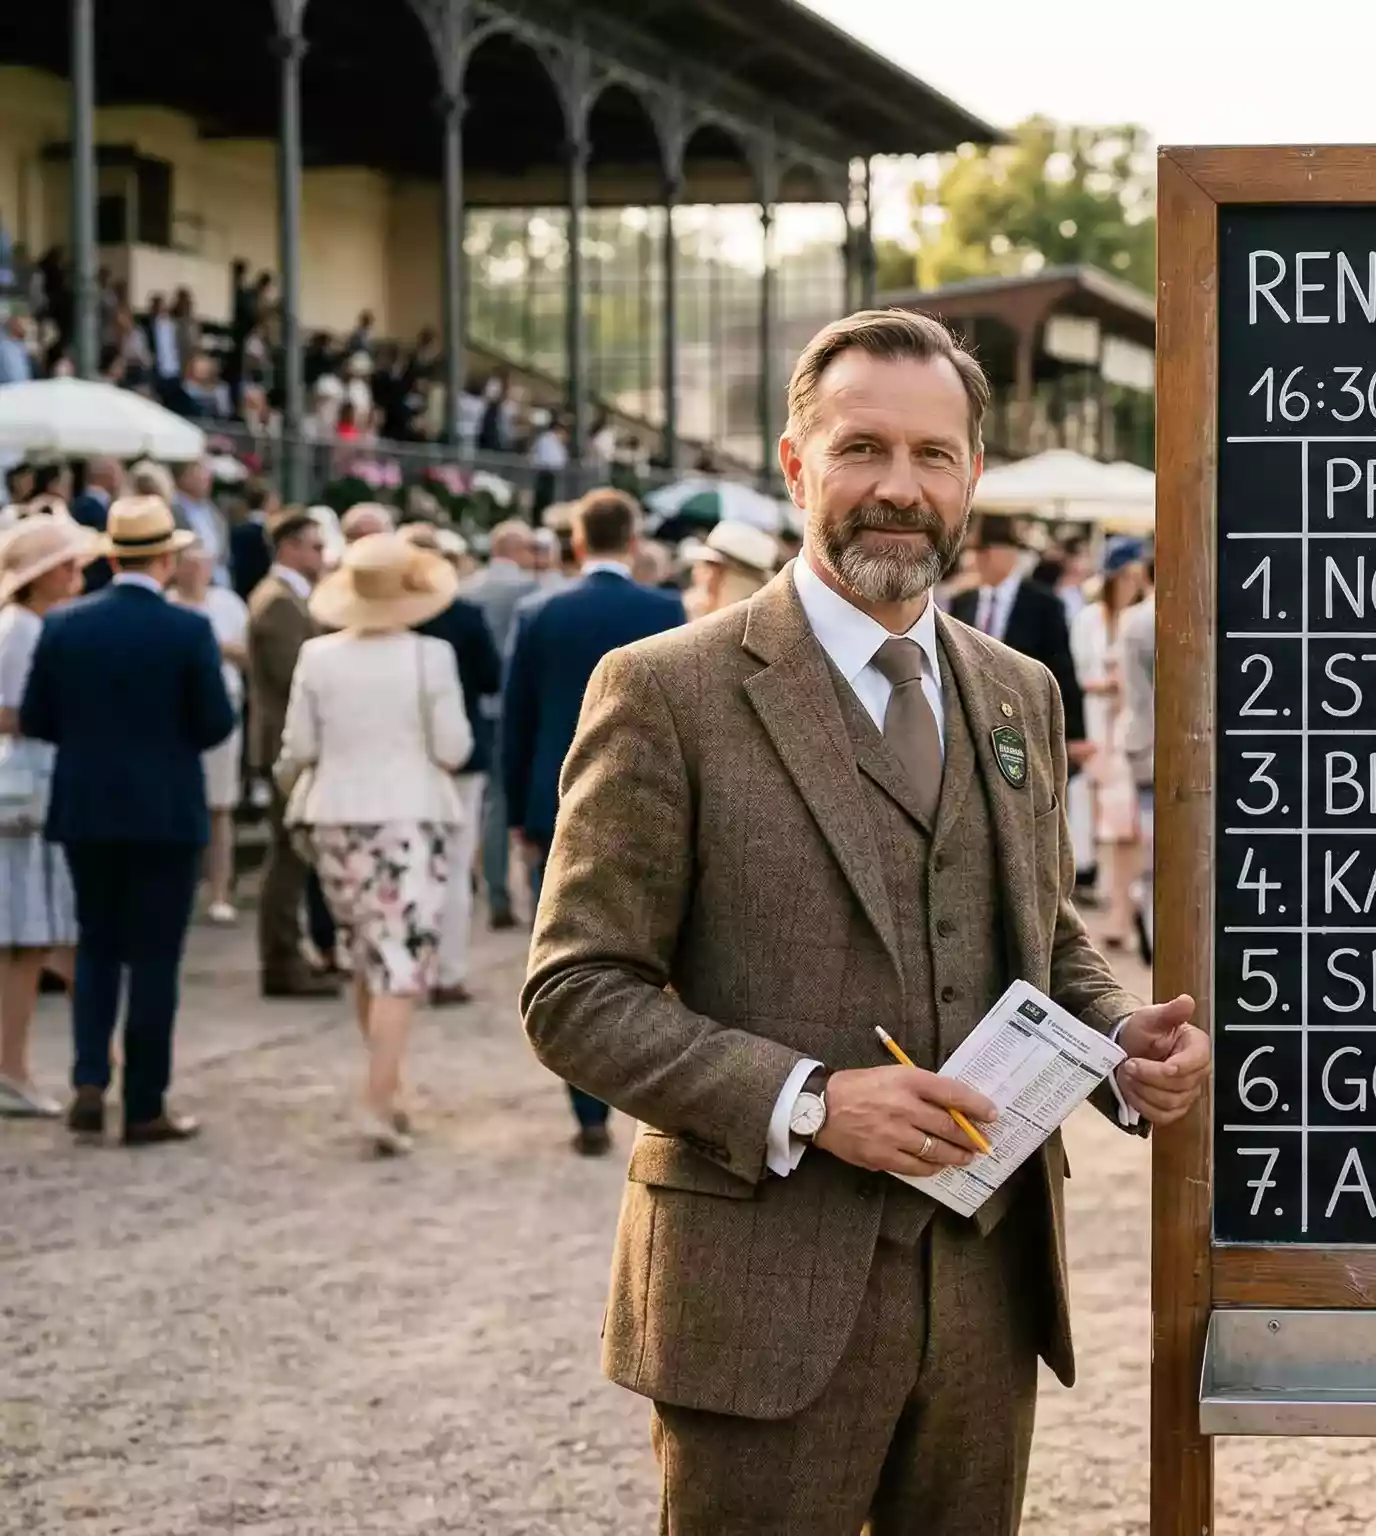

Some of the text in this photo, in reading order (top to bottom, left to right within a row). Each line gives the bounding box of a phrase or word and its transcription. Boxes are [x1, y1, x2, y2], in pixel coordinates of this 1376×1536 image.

[1241, 555, 1287, 620] 1.
[1238, 653, 1291, 717] 2.
[1236, 751, 1290, 815] 3.
[1236, 847, 1287, 916] 4.
[1236, 948, 1290, 1013] 5.
[1237, 1045, 1290, 1112] 6.
[1236, 1147, 1284, 1216] 7.
